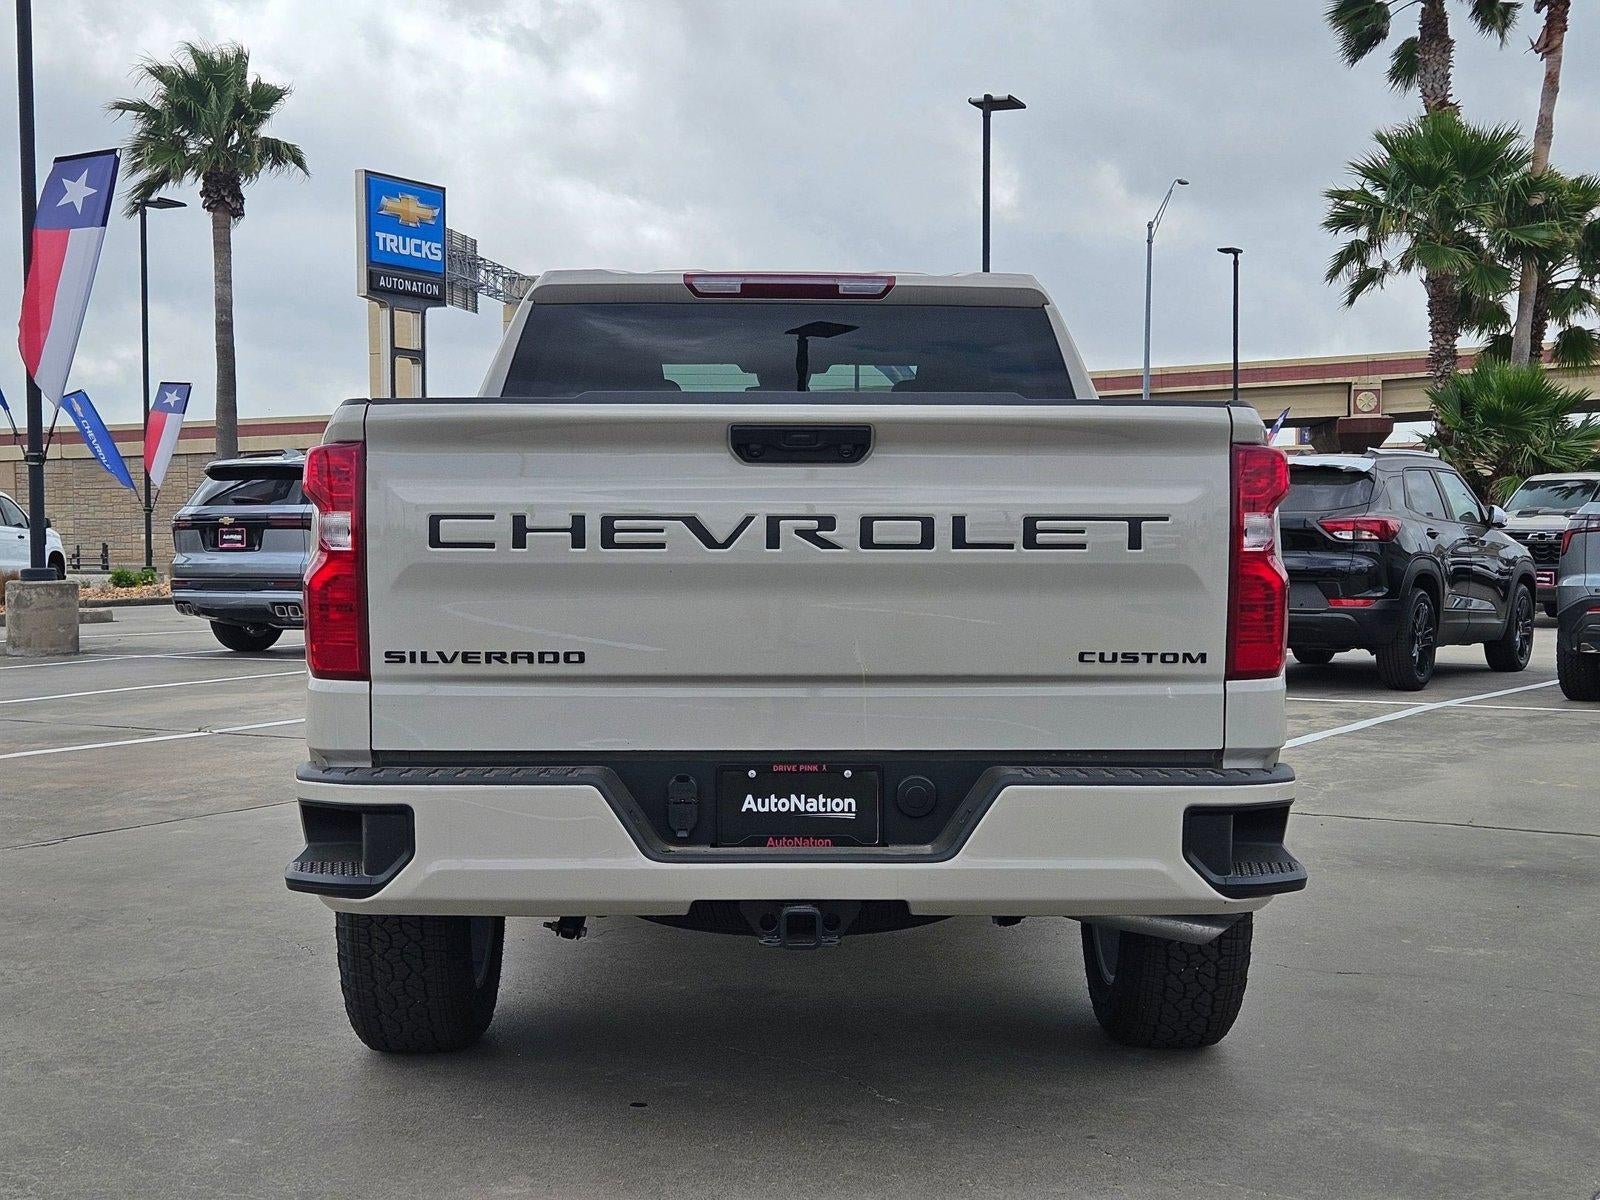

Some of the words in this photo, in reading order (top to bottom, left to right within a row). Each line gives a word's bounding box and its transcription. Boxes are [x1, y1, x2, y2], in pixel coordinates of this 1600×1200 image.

[375, 231, 442, 261] TRUCKS
[379, 275, 439, 296] AUTONATION
[428, 514, 1169, 550] CHEVROLET
[384, 650, 586, 664] SILVERADO
[1078, 651, 1207, 664] CUSTOM
[772, 764, 797, 772] DRIVE
[799, 764, 819, 772] PINK
[741, 793, 857, 813] AutoNation
[766, 836, 832, 848] AutoNation
